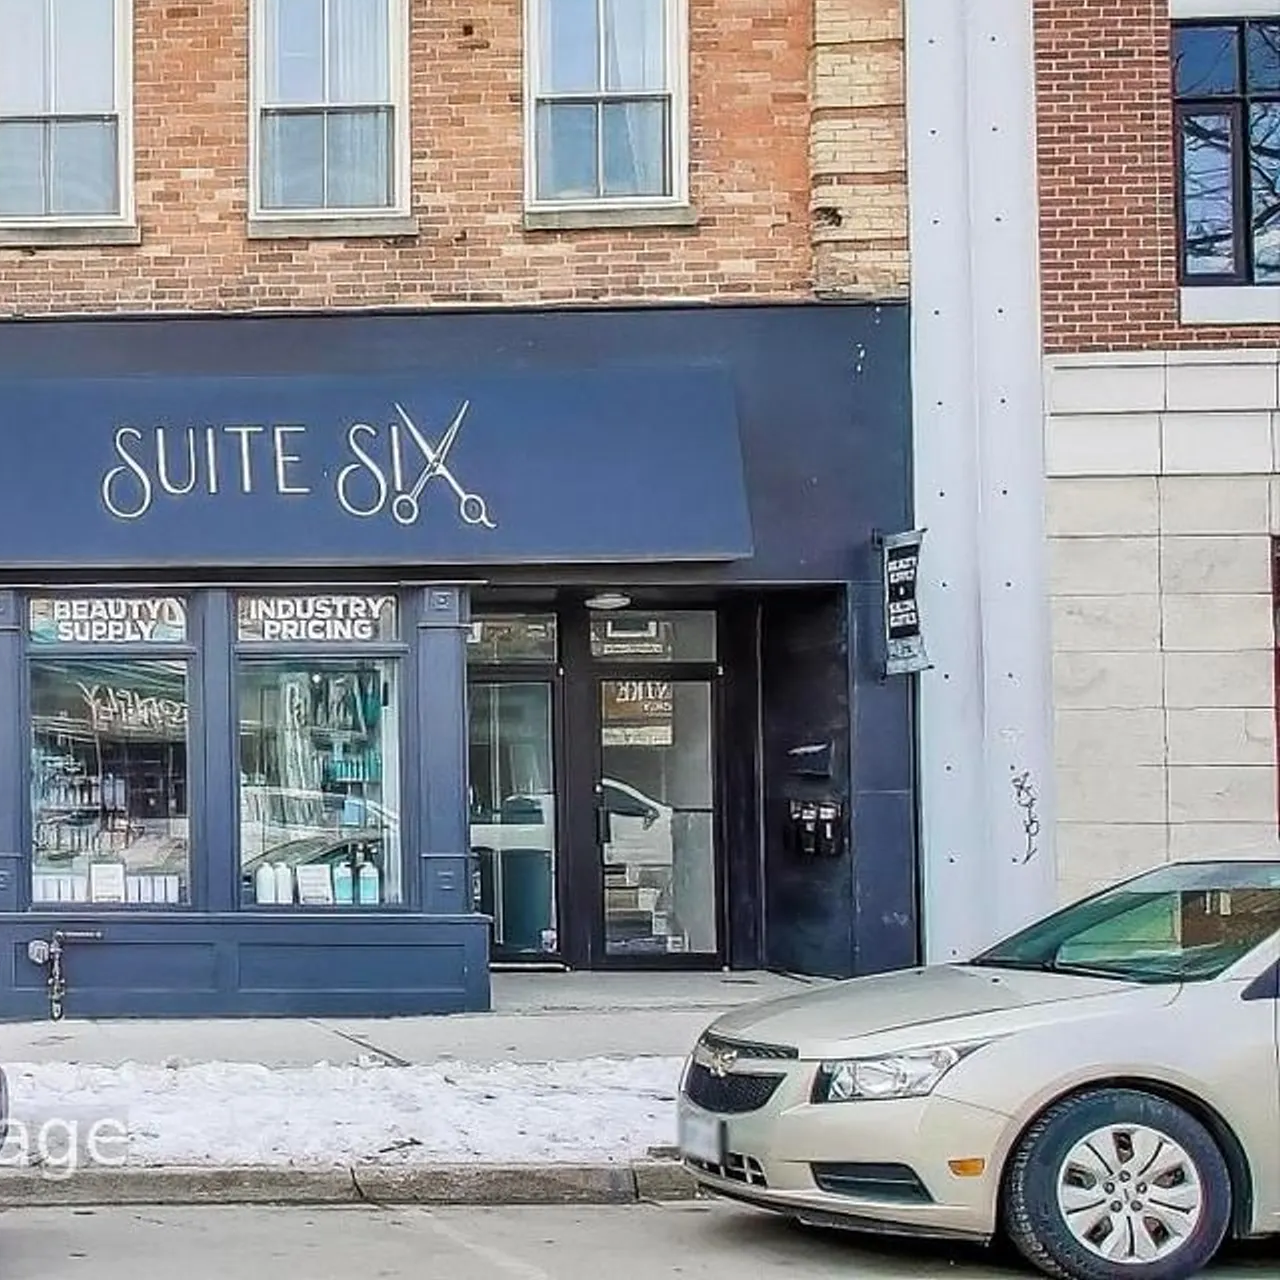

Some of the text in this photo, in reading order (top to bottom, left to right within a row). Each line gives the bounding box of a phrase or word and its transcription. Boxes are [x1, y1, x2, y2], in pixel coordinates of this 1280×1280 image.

[102, 400, 497, 529] SUITE SIX
[53, 599, 161, 620] BEAUTY
[249, 597, 384, 620] INDUSTRY
[57, 620, 156, 642] SUPPLY
[263, 620, 373, 641] PRICING
